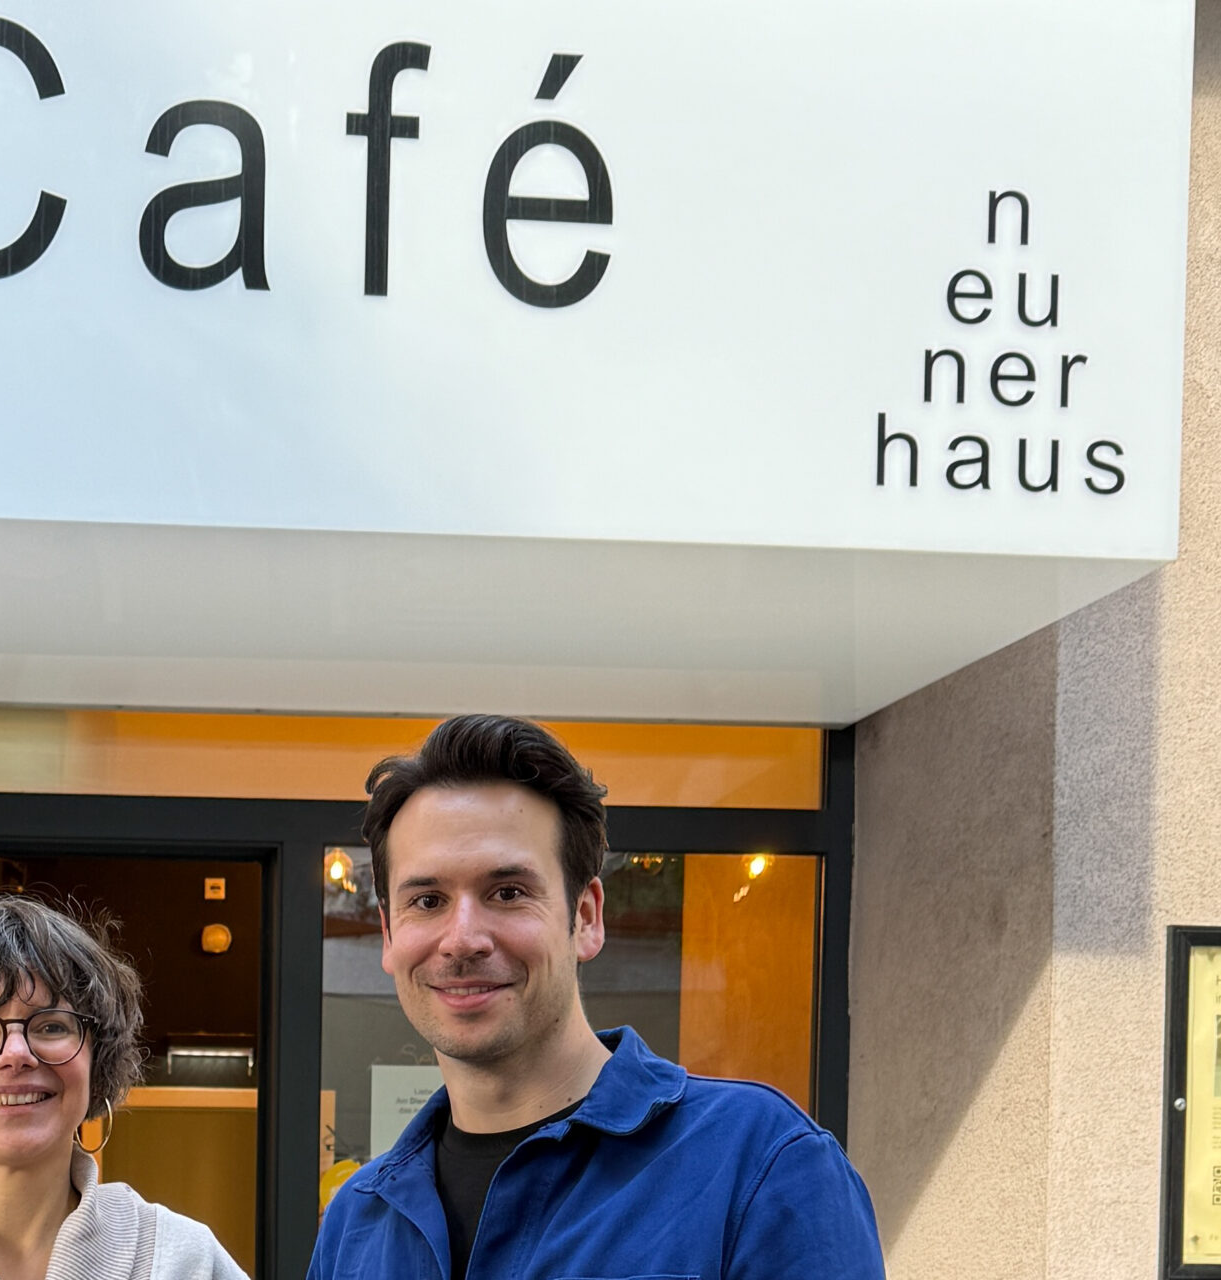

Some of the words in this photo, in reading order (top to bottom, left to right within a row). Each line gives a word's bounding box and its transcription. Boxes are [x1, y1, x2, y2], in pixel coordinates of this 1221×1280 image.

[987, 190, 1030, 246] n
[946, 269, 1059, 328] eu
[923, 349, 1088, 408] ner
[876, 404, 1125, 496] haus
